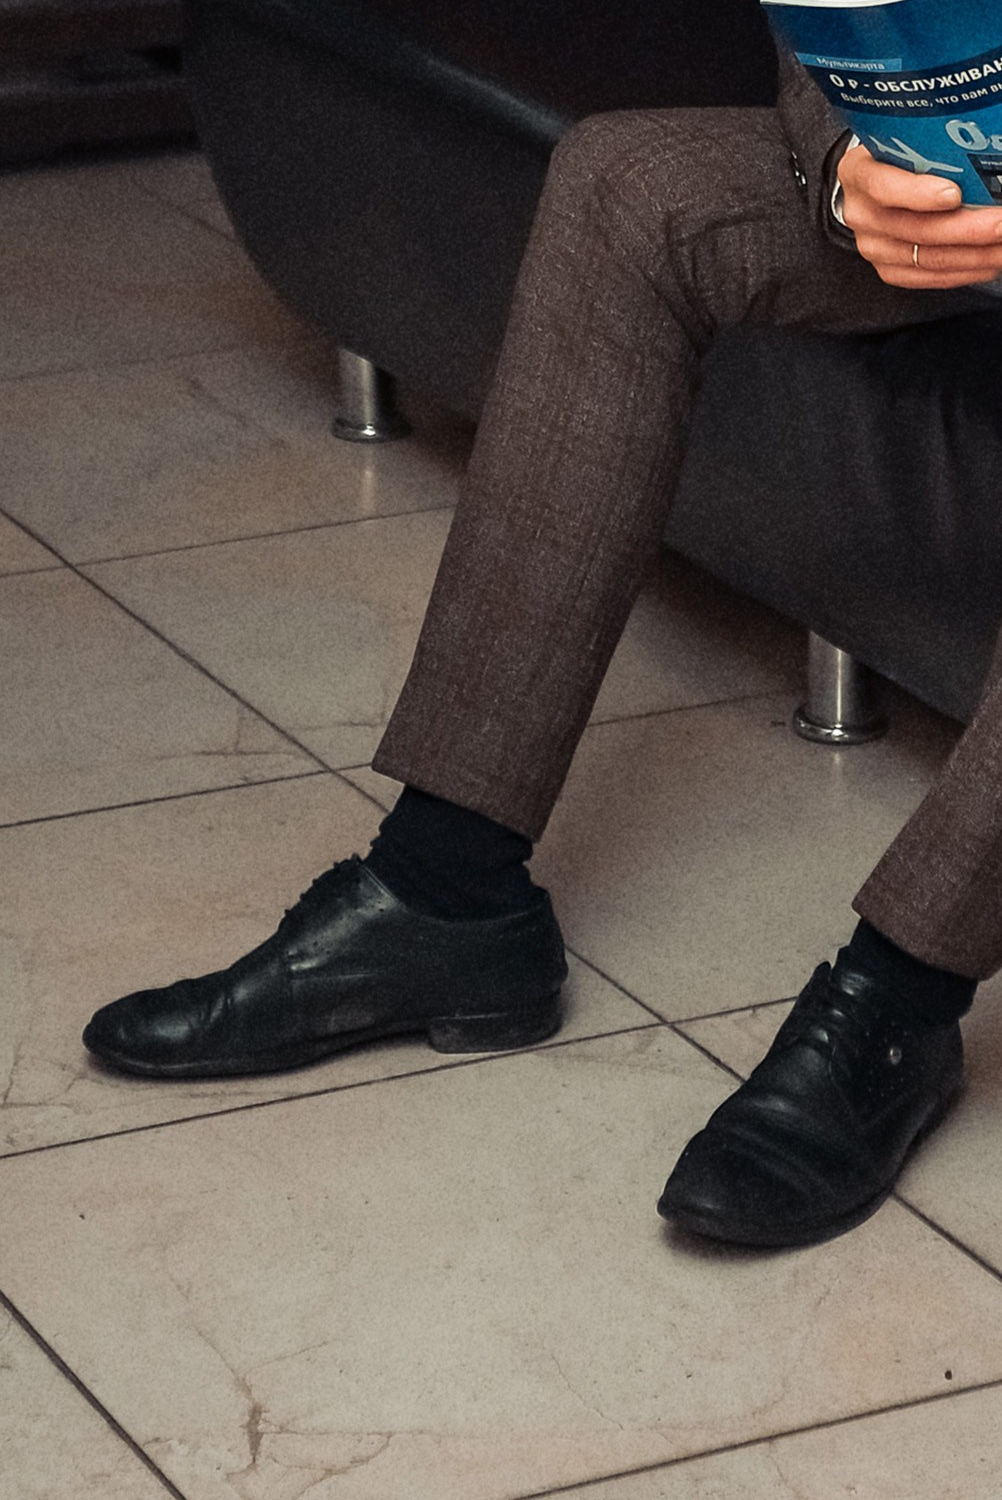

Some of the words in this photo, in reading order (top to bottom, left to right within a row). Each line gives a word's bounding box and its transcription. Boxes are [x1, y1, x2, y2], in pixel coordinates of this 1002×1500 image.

[816, 57, 885, 71] Мультикарта
[840, 92, 904, 108] Выберите
[935, 95, 959, 105] что
[961, 87, 989, 101] вам
